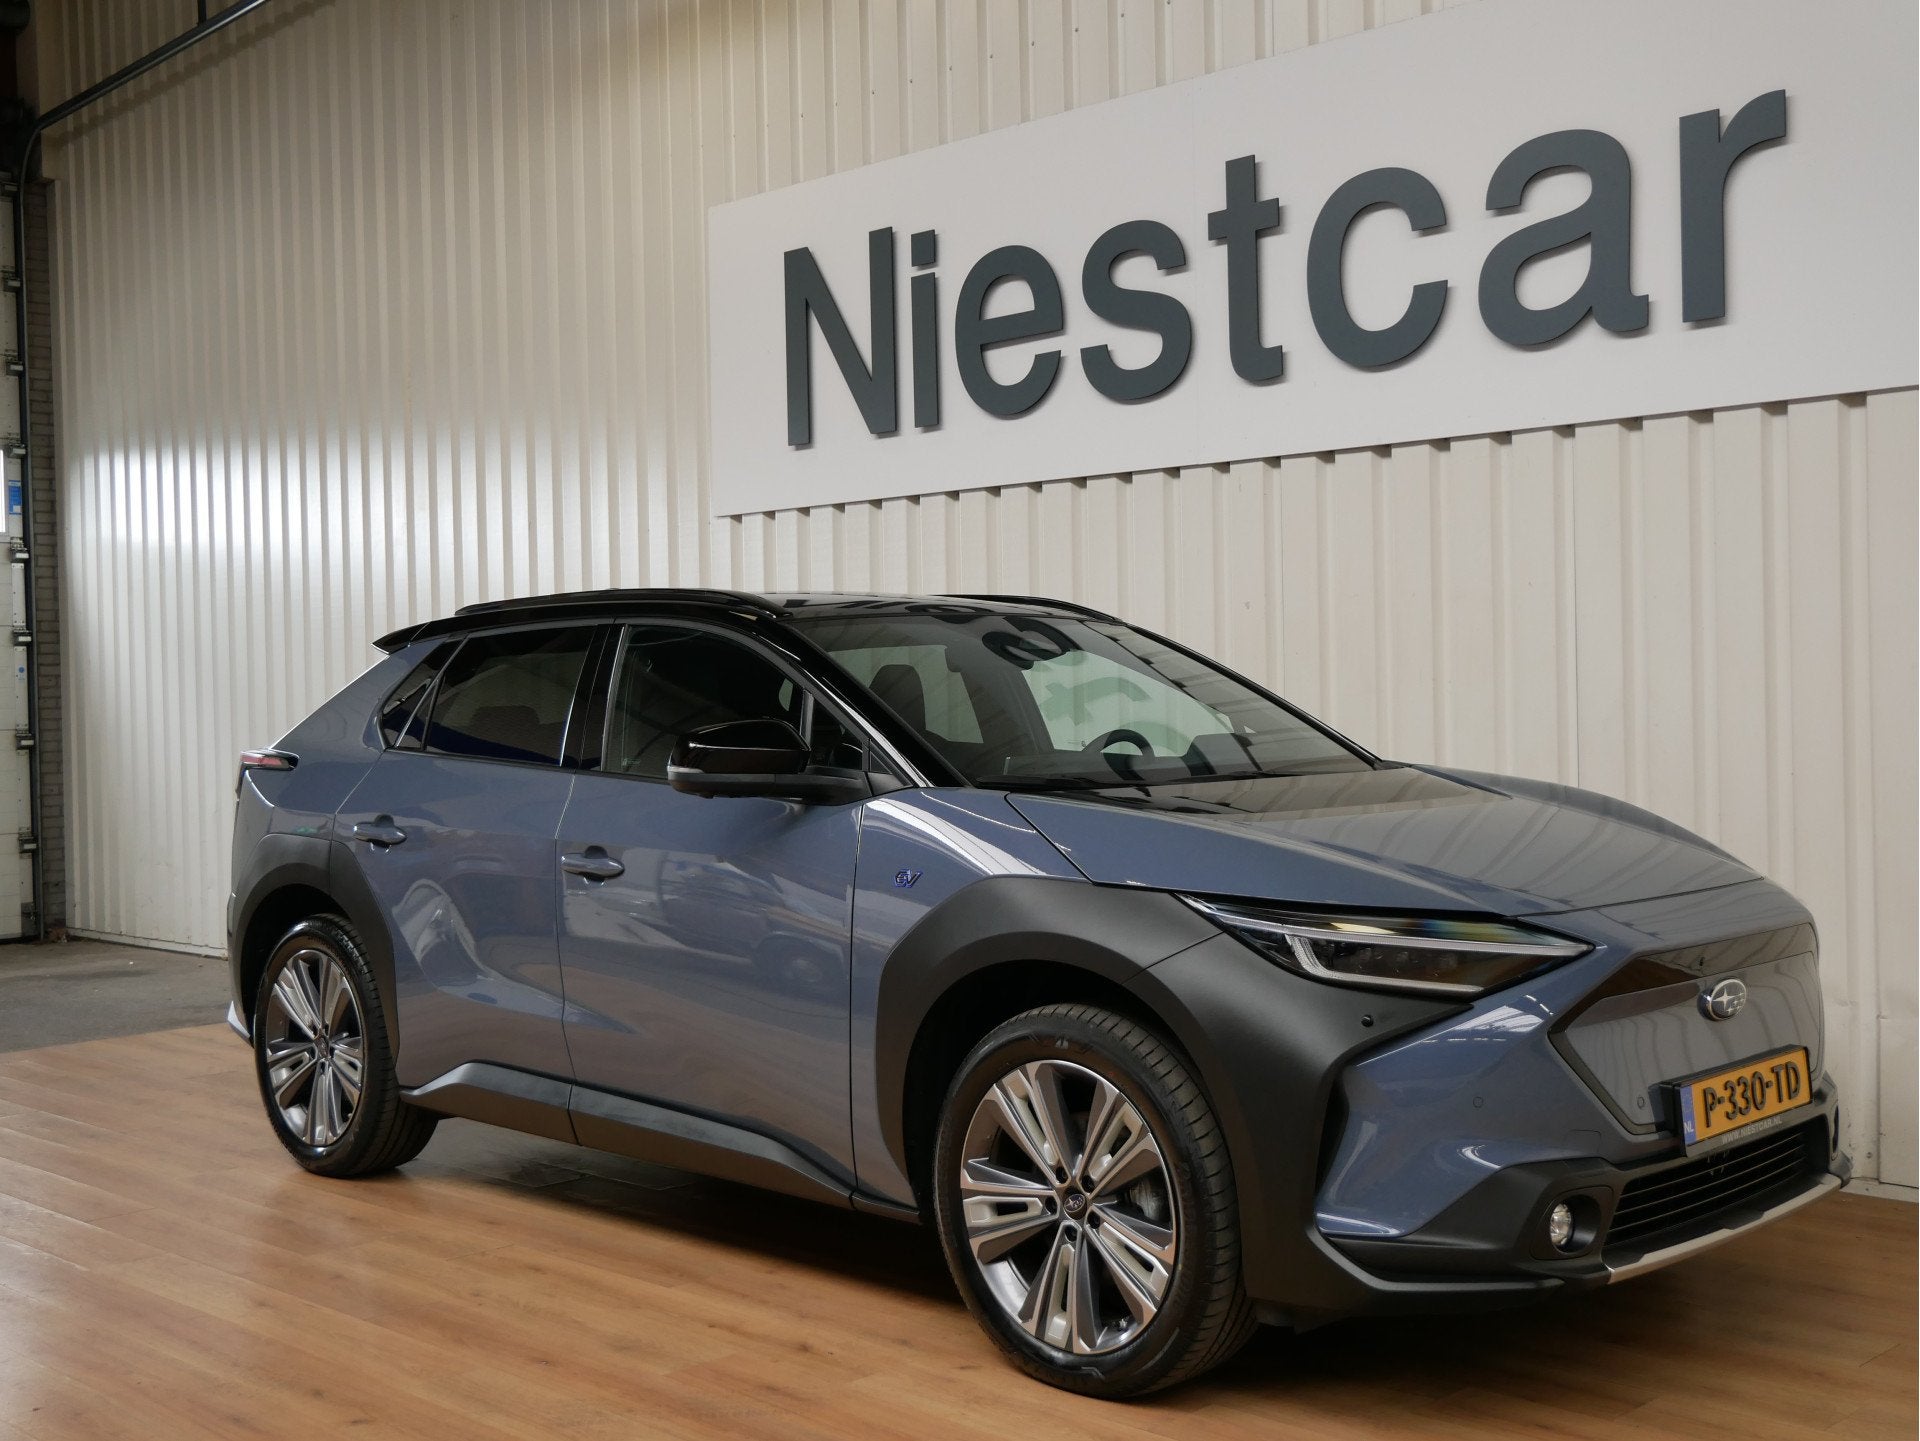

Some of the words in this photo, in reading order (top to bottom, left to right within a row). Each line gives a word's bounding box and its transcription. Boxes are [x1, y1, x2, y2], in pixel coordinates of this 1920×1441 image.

[784, 89, 1787, 448] Niestcar
[1702, 1061, 1801, 1128] P-330-TD
[1684, 1121, 1694, 1134] NL
[1721, 1117, 1783, 1145] WWW.NIESTCAR.NL
